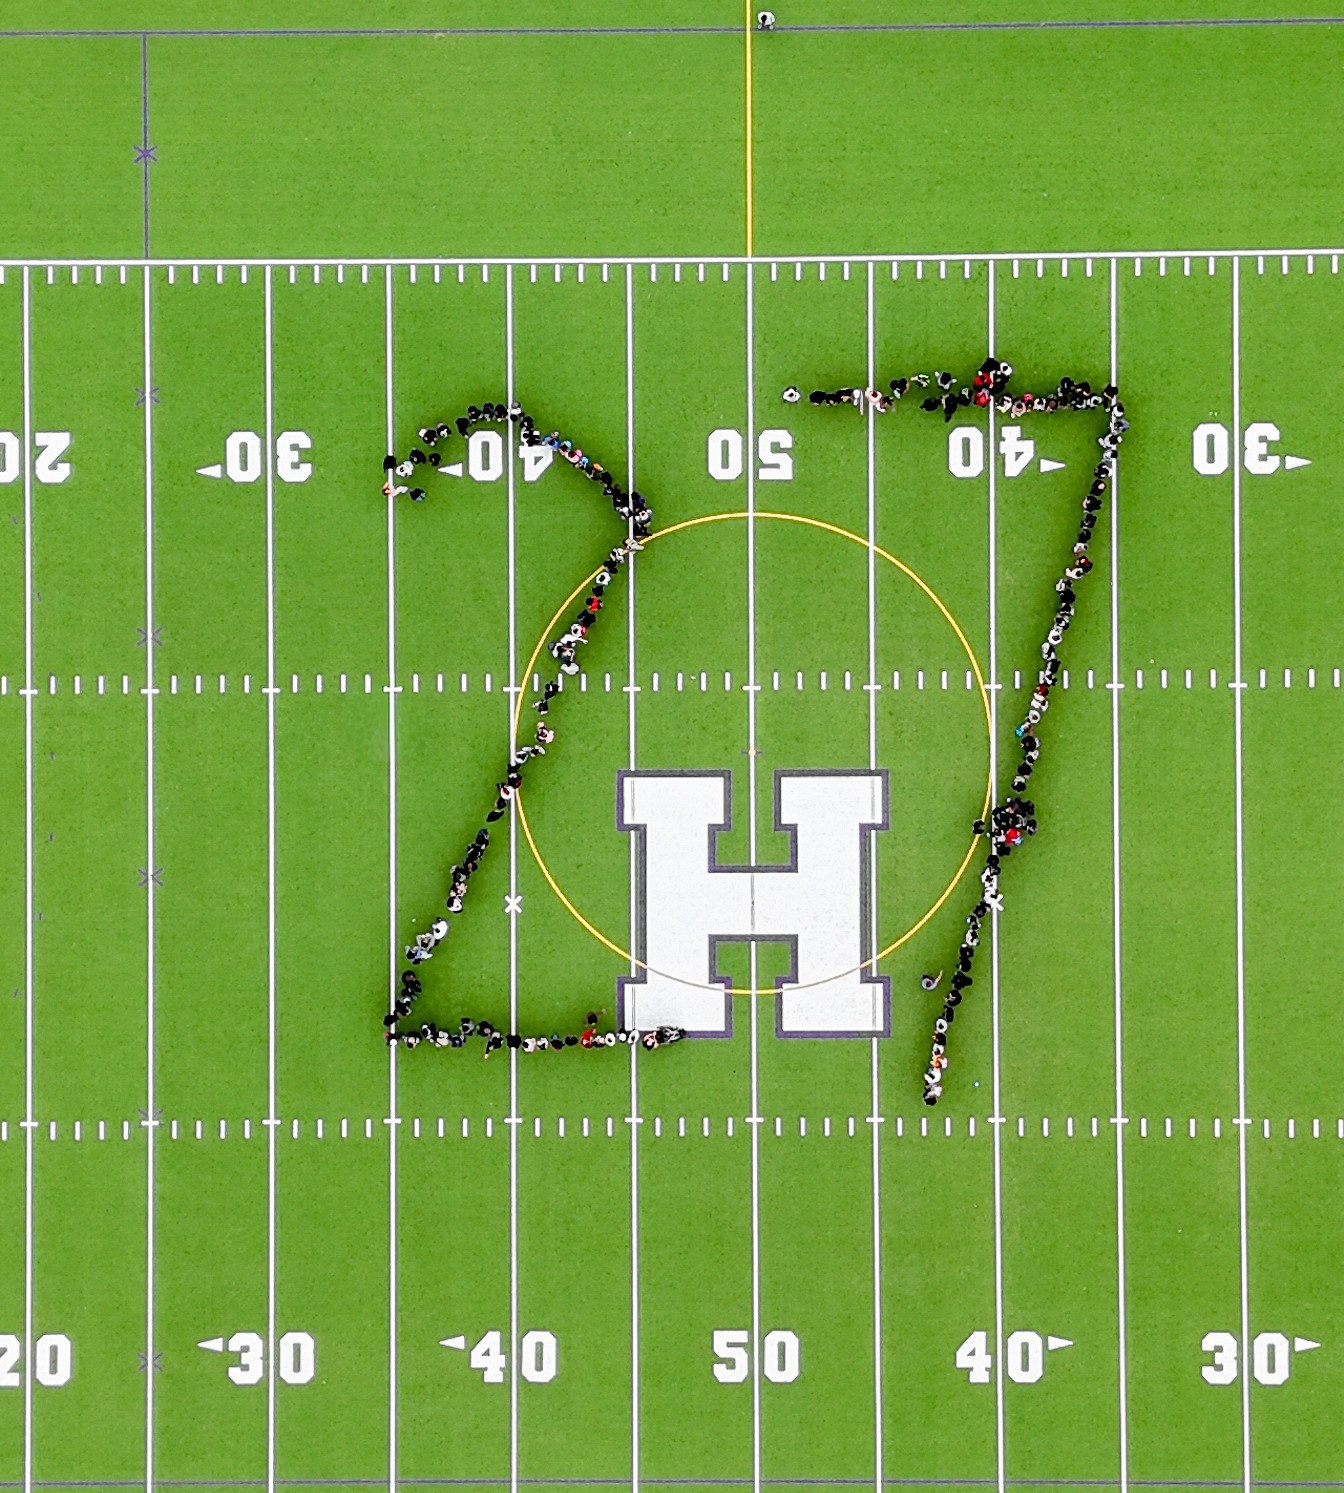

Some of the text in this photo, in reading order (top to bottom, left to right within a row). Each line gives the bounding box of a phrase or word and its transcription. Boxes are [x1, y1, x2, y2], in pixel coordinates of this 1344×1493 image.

[225, 431, 313, 483] 30
[468, 430, 554, 482] 40
[708, 429, 794, 481] 50
[948, 426, 1035, 478] 40
[1193, 422, 1281, 475] 30
[617, 768, 891, 1038] H
[227, 1332, 315, 1385] 30
[470, 1330, 558, 1383] 40
[713, 1330, 800, 1383] 50
[955, 1330, 1044, 1384] 40
[1201, 1332, 1290, 1385] 30
